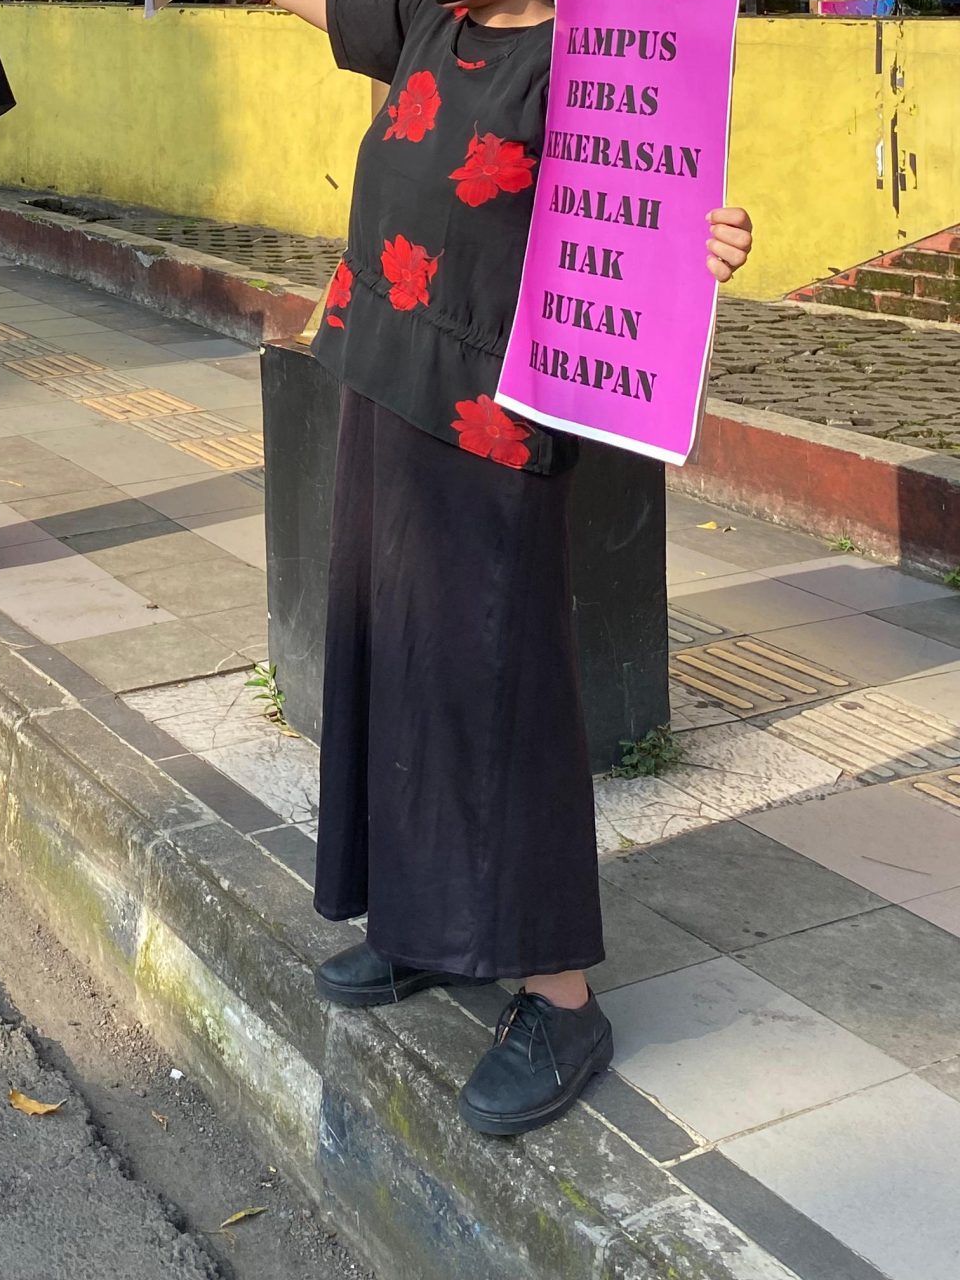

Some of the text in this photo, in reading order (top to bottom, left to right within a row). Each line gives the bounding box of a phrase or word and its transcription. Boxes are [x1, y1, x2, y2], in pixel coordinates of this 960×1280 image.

[566, 27, 677, 61] KAMPUS
[566, 80, 658, 115] BEBAS
[546, 130, 701, 178] KEKERASAN
[549, 185, 661, 229] ADALAH
[558, 240, 624, 281] HAK
[542, 290, 641, 340] BUKAN
[529, 340, 657, 403] HARAPAN
